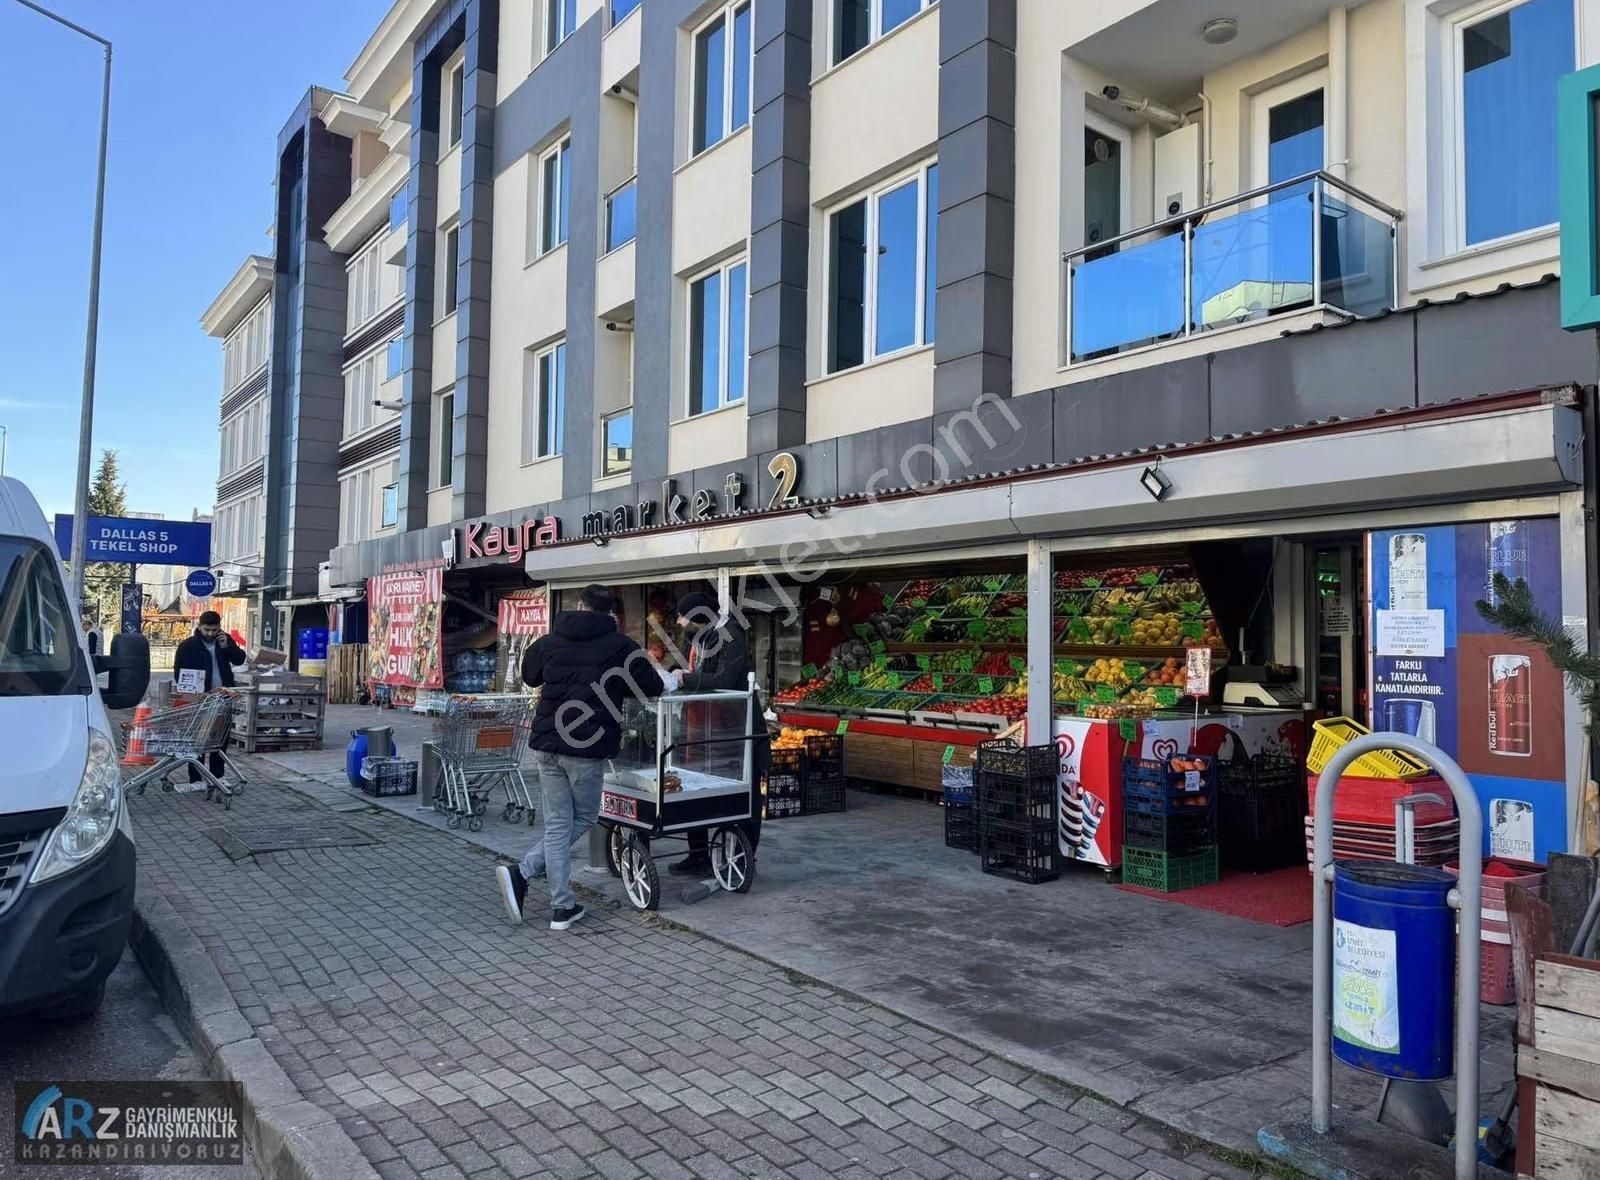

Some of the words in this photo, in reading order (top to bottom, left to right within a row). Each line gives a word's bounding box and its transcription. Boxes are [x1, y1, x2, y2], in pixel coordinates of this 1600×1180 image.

[465, 516, 558, 563] Kayra
[582, 472, 743, 536] market
[767, 452, 802, 508] 2
[101, 528, 156, 541] DALLAS
[160, 531, 169, 542] 5
[90, 540, 136, 552] TEKEL
[139, 543, 178, 554] SHOP
[1395, 660, 1422, 670] FARKLI
[1390, 672, 1428, 682] TATLARLA
[1489, 710, 1497, 729] Bull
[1489, 730, 1497, 750] Red
